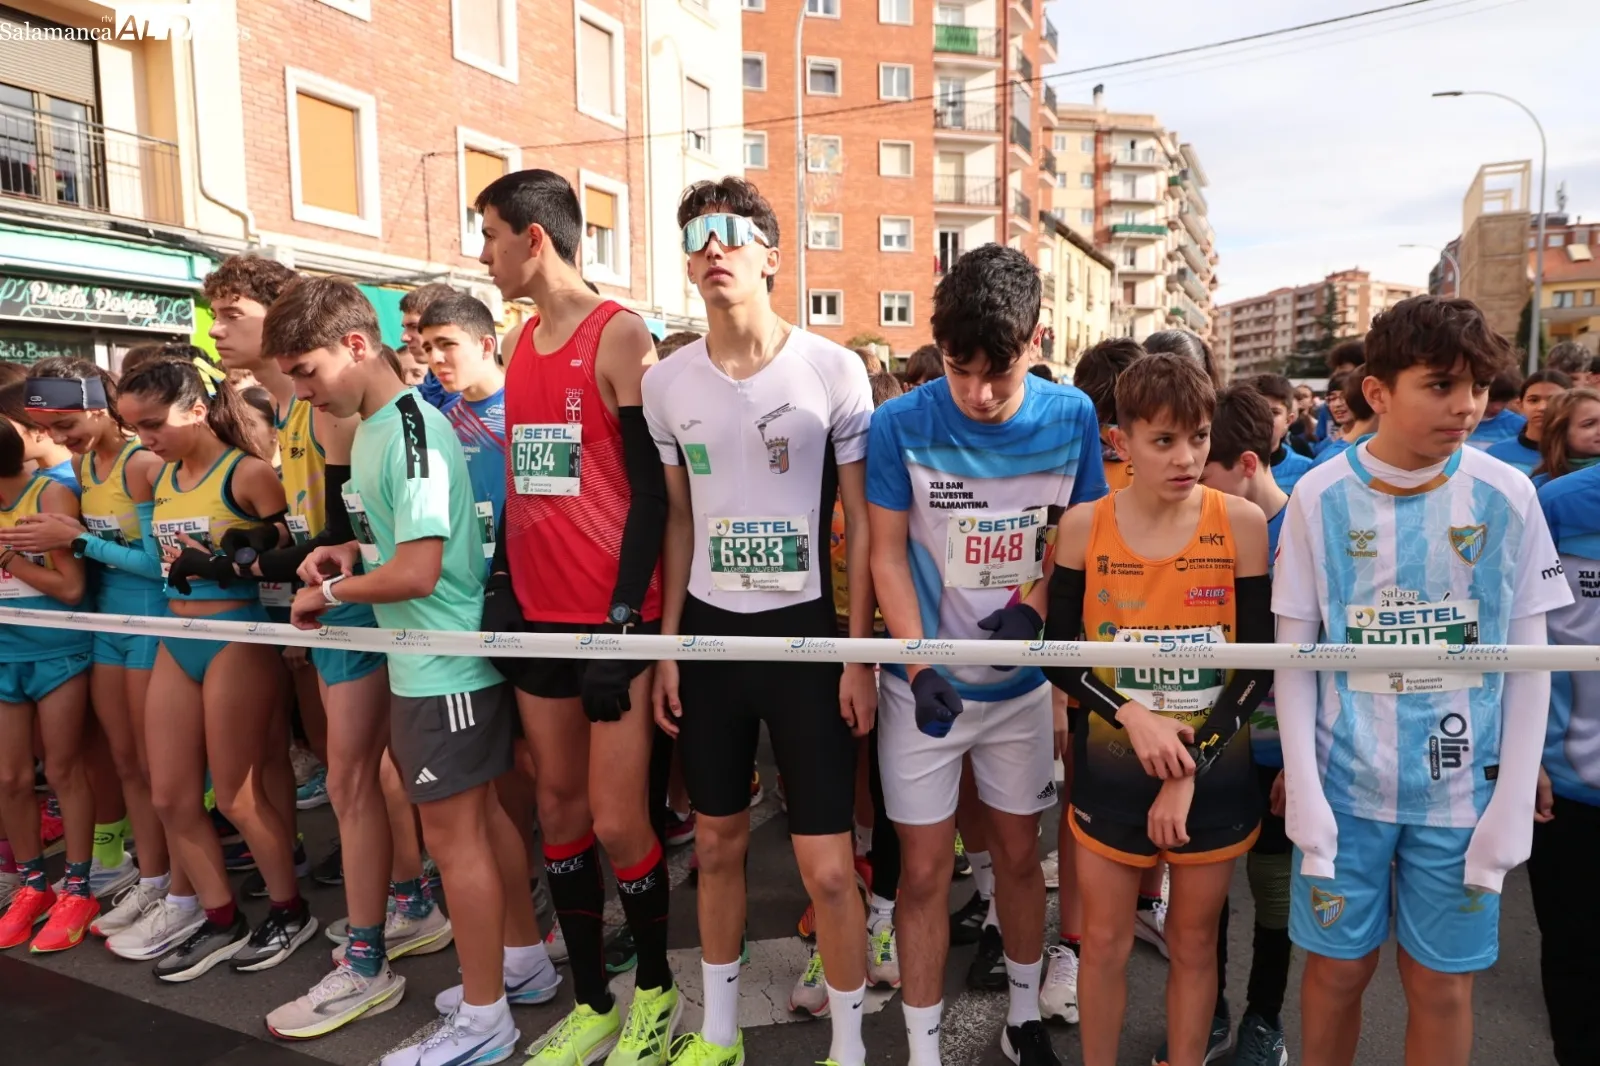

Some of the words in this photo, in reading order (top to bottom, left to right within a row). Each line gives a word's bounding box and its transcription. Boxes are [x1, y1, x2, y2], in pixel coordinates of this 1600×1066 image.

[524, 428, 572, 439] SETEL
[517, 443, 555, 471] 6134
[929, 482, 944, 490] XLI
[945, 482, 964, 490] SAN
[929, 491, 974, 500] SILVESTRE
[929, 501, 989, 509] SALMANTINA
[88, 517, 113, 529] ETEL
[159, 521, 202, 533] SETEL
[732, 521, 799, 534] SETEL
[978, 514, 1040, 533] SETEL
[720, 537, 785, 567] 6333
[965, 533, 1024, 565] 6148
[1346, 548, 1378, 558] hummel
[1381, 587, 1419, 600] sabor
[1378, 607, 1466, 626] SETEL
[1152, 684, 1183, 692] DAMASO
[1439, 712, 1470, 769] Olin
